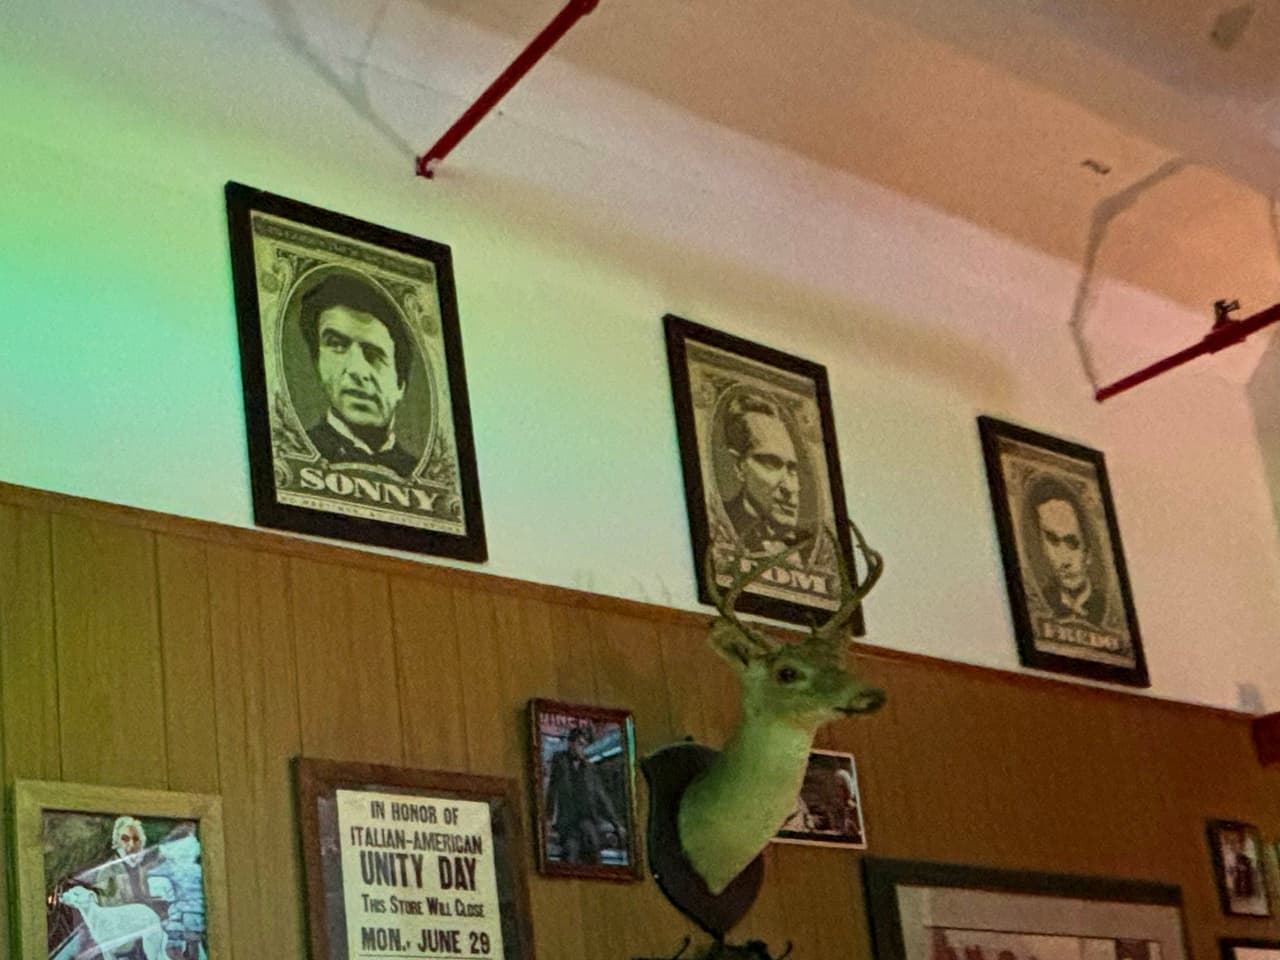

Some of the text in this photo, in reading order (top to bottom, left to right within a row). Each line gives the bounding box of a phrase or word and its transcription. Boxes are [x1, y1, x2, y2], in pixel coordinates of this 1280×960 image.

[299, 467, 438, 512] SONNY
[371, 801, 459, 825] IN HONOR OF
[350, 826, 483, 855] ITALIAN-AMERICAN
[360, 851, 477, 891] UNITY DAY
[417, 928, 462, 952] JUNE
[469, 931, 491, 955] 29
